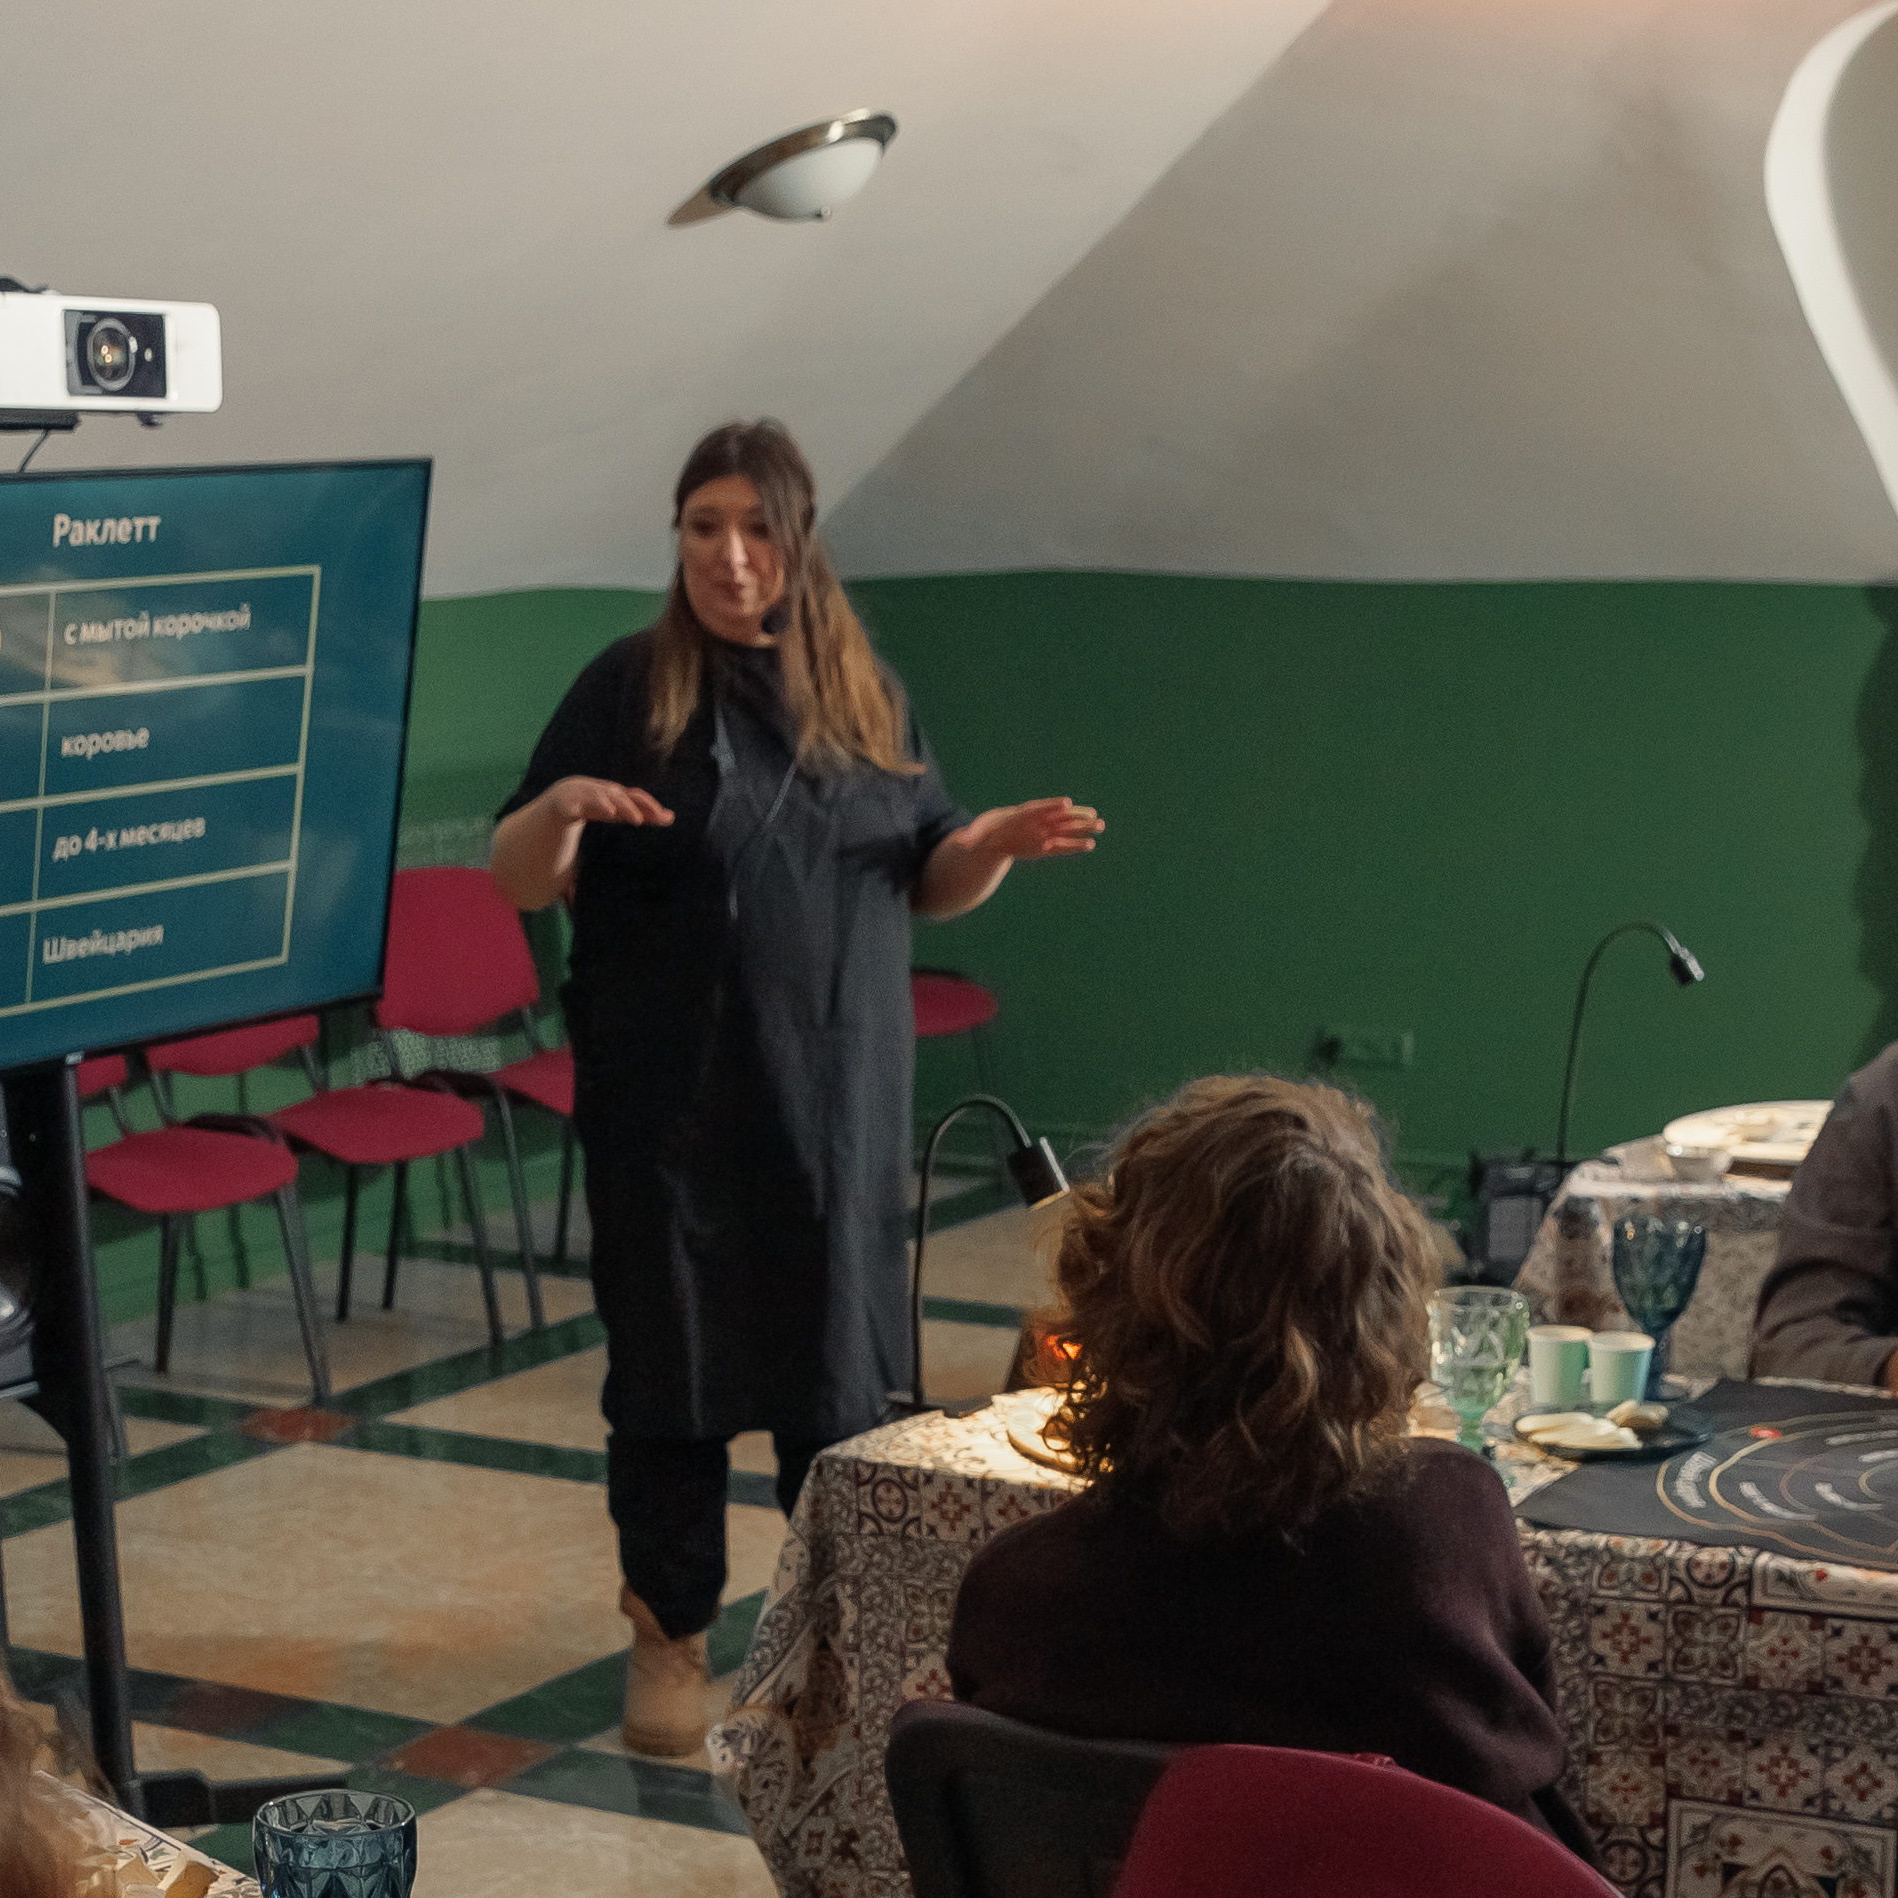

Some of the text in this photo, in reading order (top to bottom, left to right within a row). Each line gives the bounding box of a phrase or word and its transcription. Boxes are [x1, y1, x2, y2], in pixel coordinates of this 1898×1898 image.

[52, 512, 161, 548] Раклетт
[79, 610, 150, 643] мытой
[153, 602, 251, 640] корочкой
[61, 727, 150, 760] коровье
[52, 835, 82, 862] до
[120, 816, 206, 849] месяцев
[42, 924, 165, 965] Швейцария
